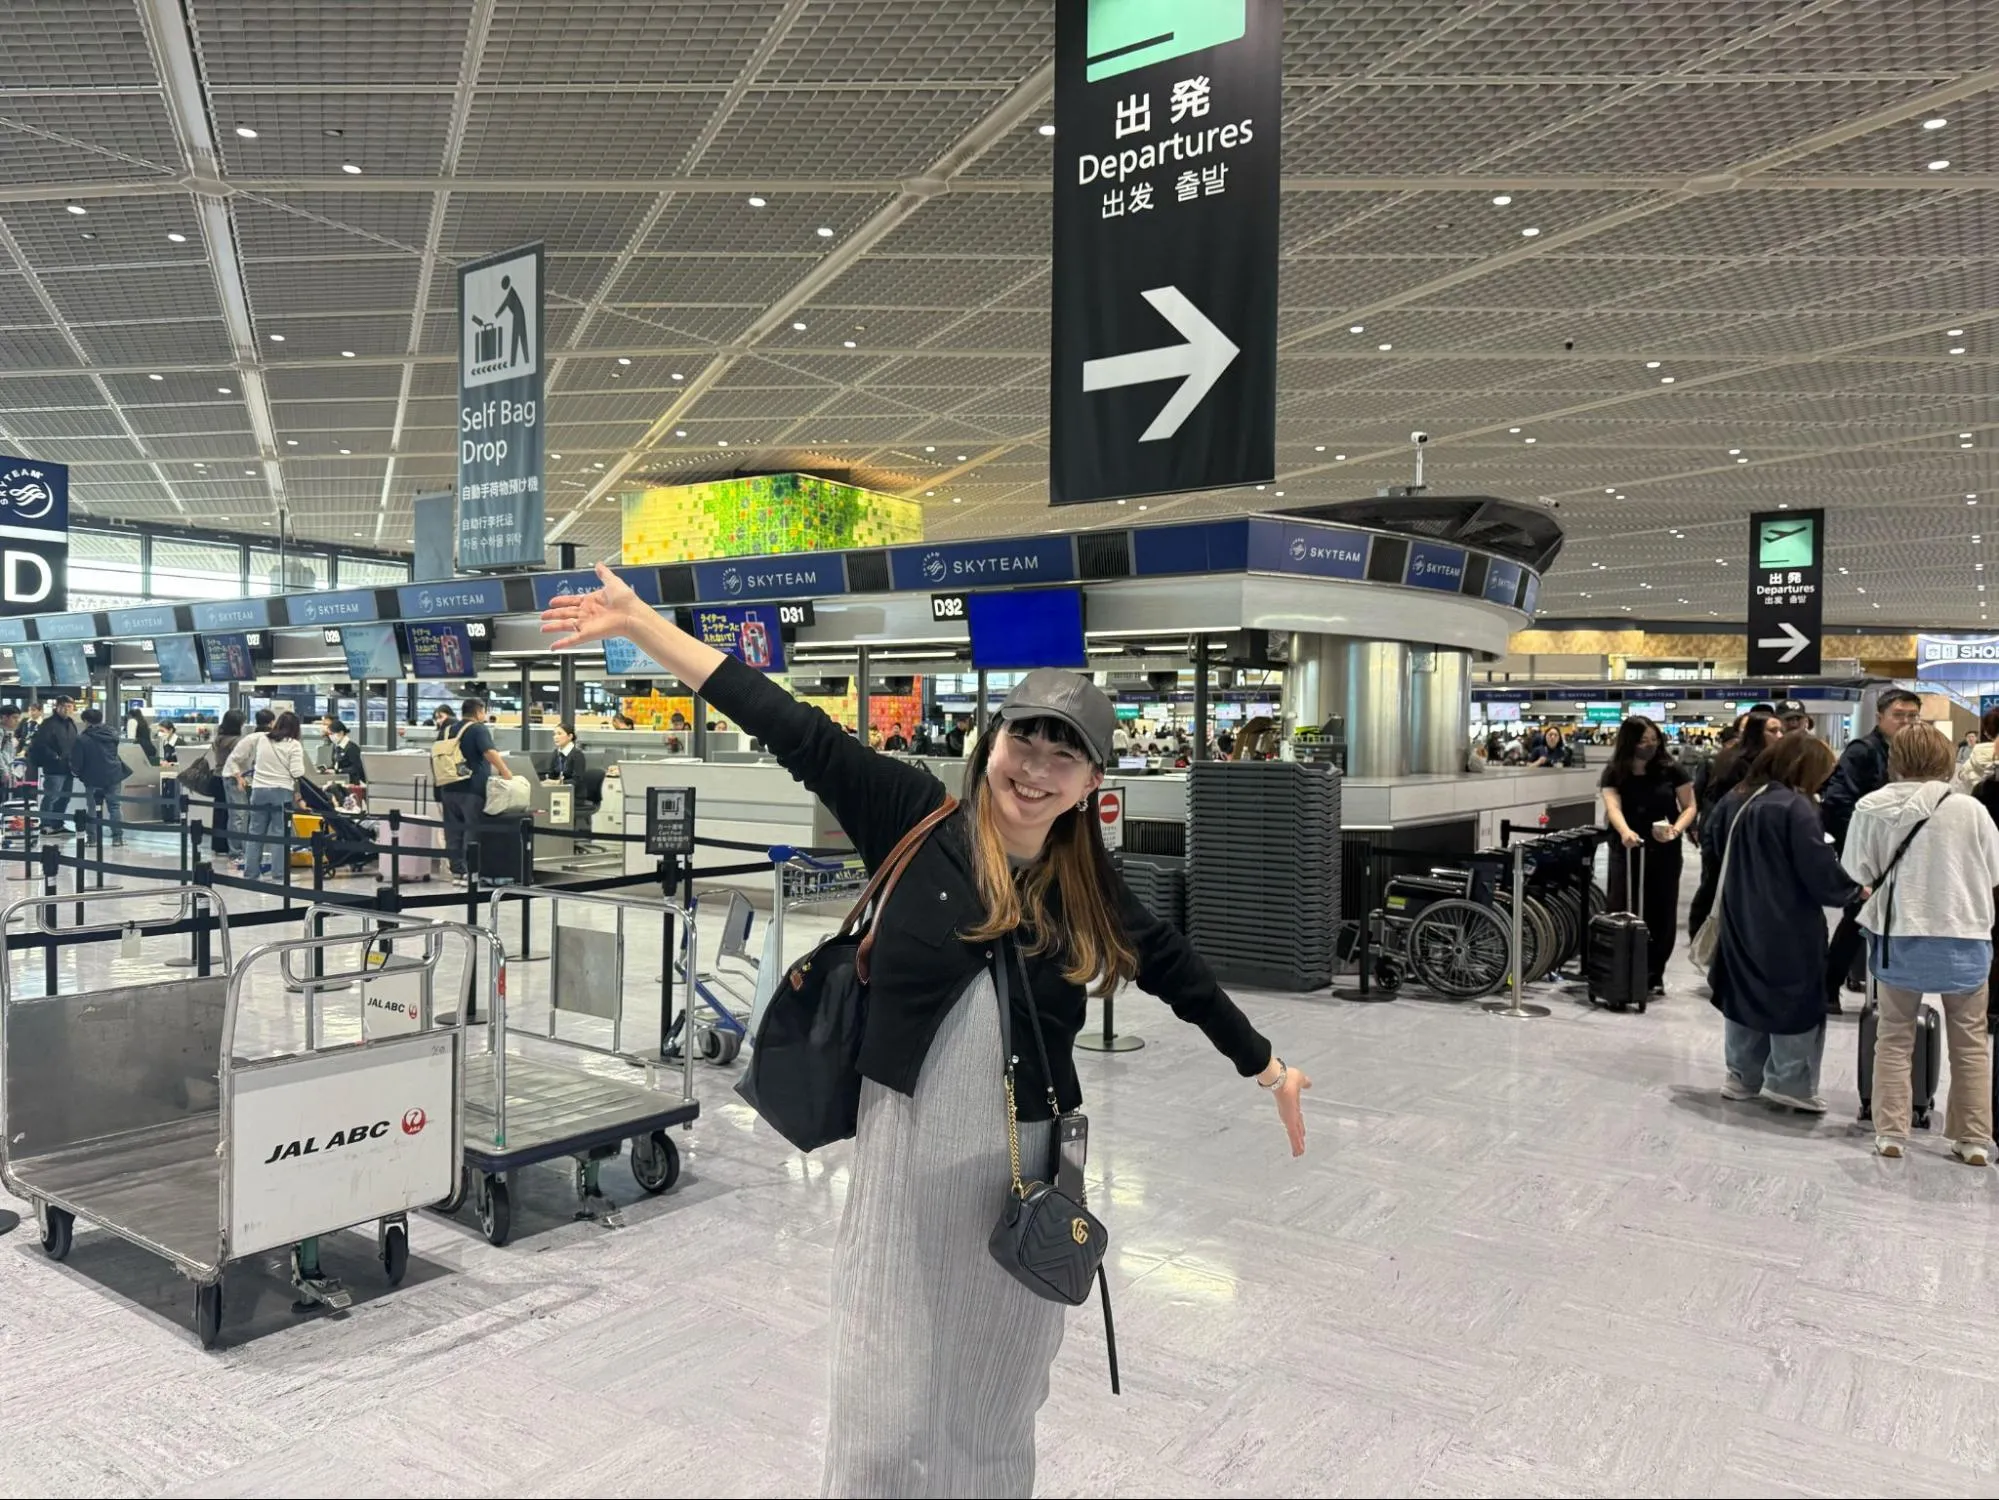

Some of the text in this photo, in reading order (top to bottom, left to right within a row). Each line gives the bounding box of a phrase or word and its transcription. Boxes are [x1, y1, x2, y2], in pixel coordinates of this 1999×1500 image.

[1115, 75, 1211, 139] 出発
[1078, 119, 1253, 185] Departures
[1102, 162, 1229, 219] 出发 출발
[462, 400, 536, 432] Self Bag
[463, 440, 508, 466] Drop
[953, 555, 1039, 574] SKYTEAM
[1310, 548, 1361, 563] SKYTEAM
[4, 550, 52, 602] D
[1426, 562, 1461, 576] SKYTEAM
[748, 571, 817, 588] SKYTEAM
[1757, 585, 1815, 596] Departures
[319, 603, 359, 615] SKYTEAM
[436, 594, 485, 608] SKYTEAM
[933, 598, 963, 617] D32
[780, 606, 804, 623] D31
[466, 623, 486, 637] D29
[367, 998, 405, 1013] JAL ABC
[264, 1120, 390, 1164] JAL ABC
